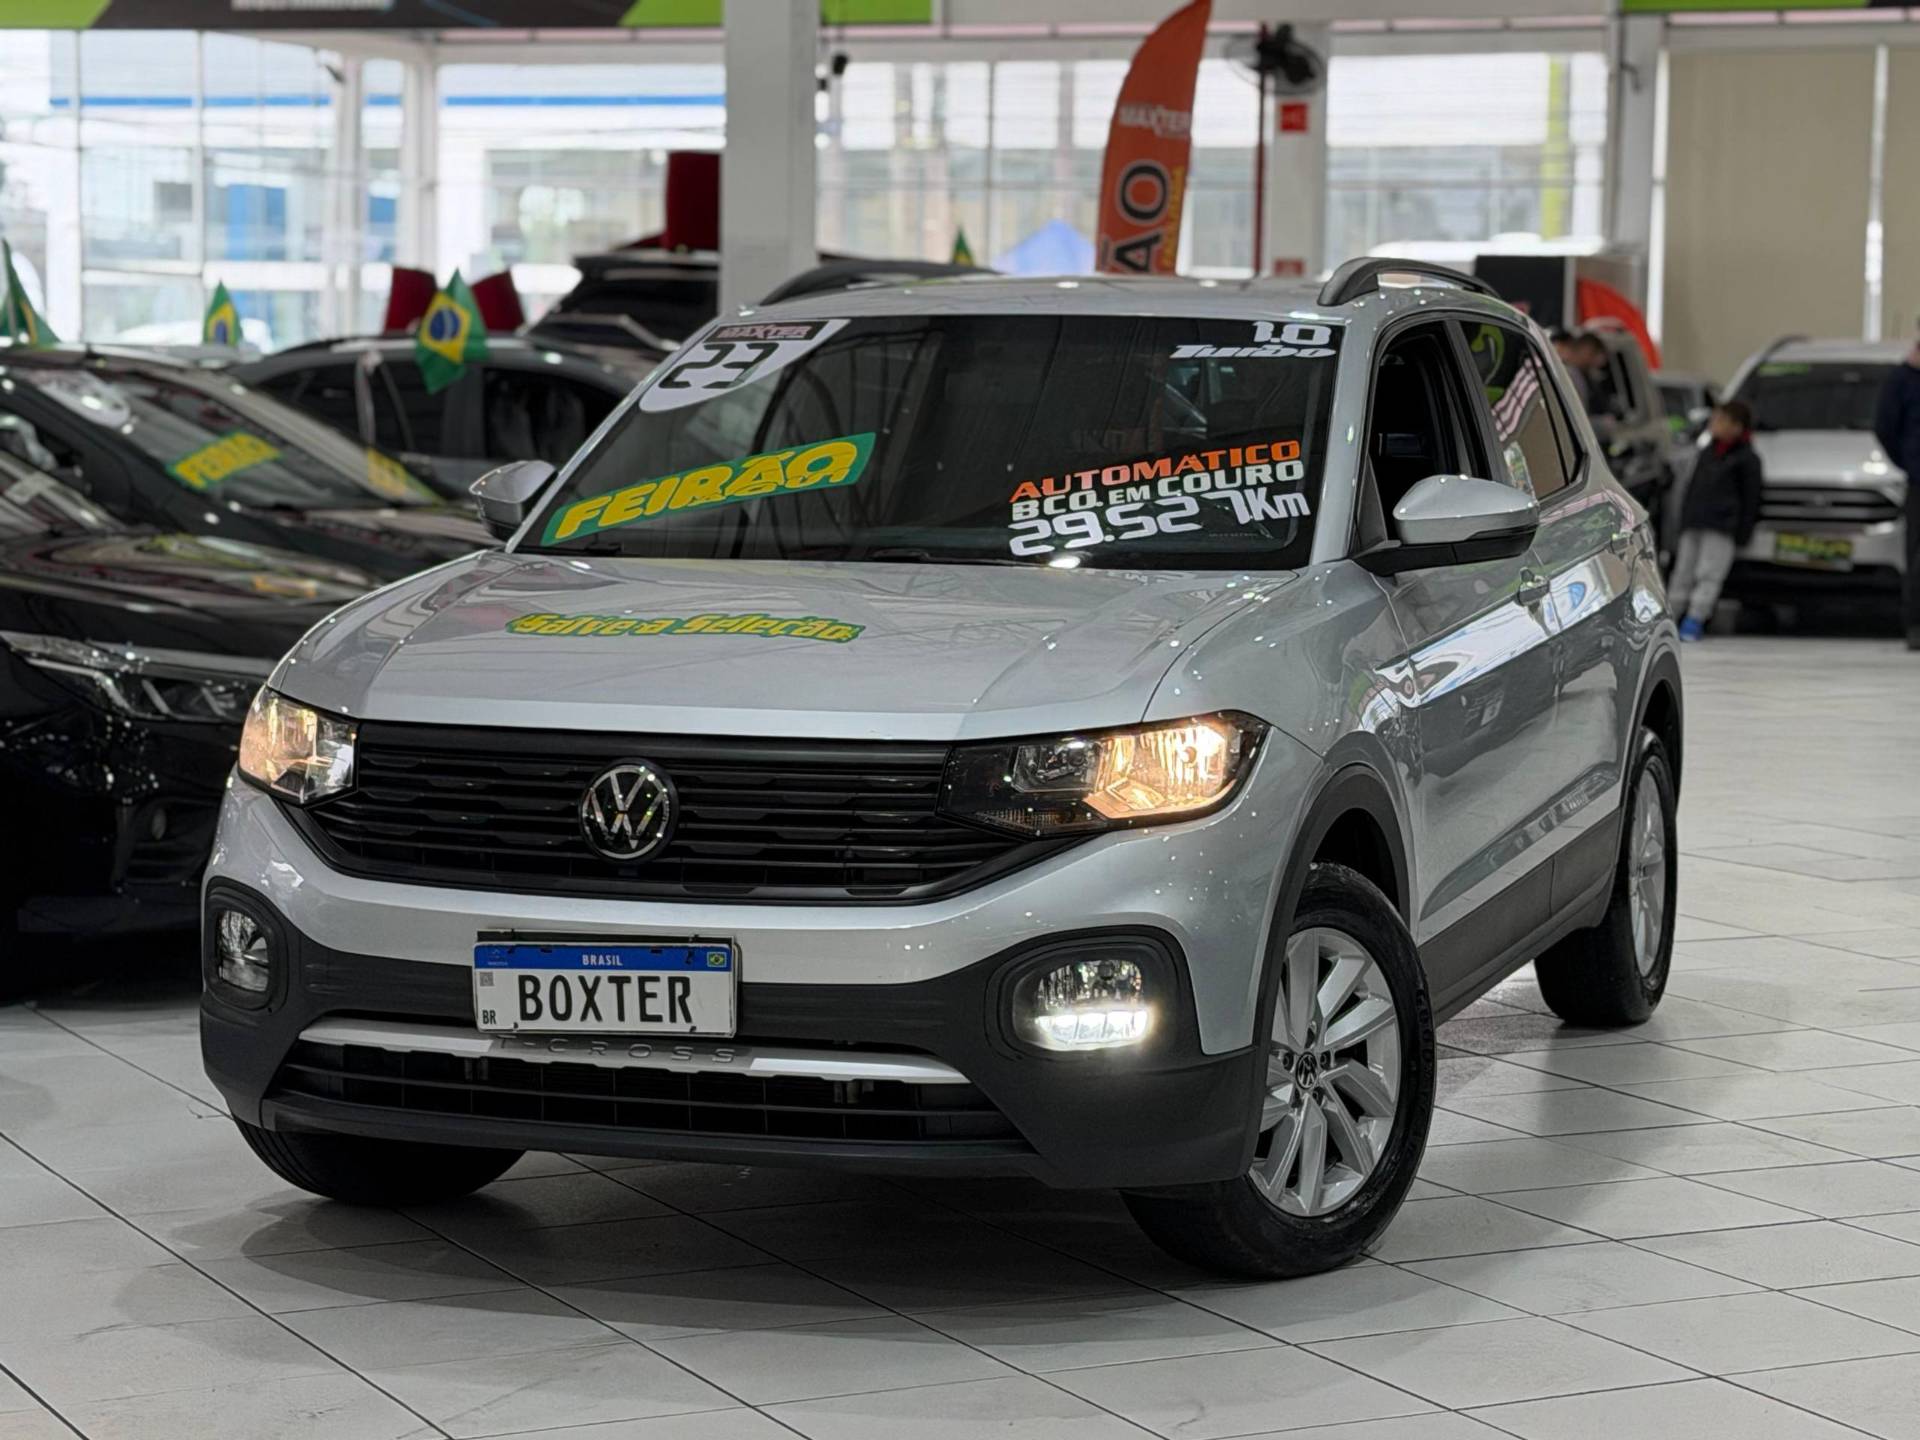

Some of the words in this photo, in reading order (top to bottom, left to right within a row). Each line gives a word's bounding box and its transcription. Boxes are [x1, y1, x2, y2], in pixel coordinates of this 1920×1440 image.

[714, 324, 812, 339] MAXTER
[1252, 320, 1332, 346] 1.0
[1168, 343, 1337, 359] Turbo
[658, 342, 780, 389] 23
[554, 441, 858, 540] FEIRÃO
[1108, 485, 1151, 505] EM
[1157, 459, 1304, 497] COURO
[581, 953, 623, 967] BRASIL
[517, 974, 694, 1024] BOXTER
[482, 1009, 497, 1026] BR
[497, 1035, 736, 1063] T-CROSS
